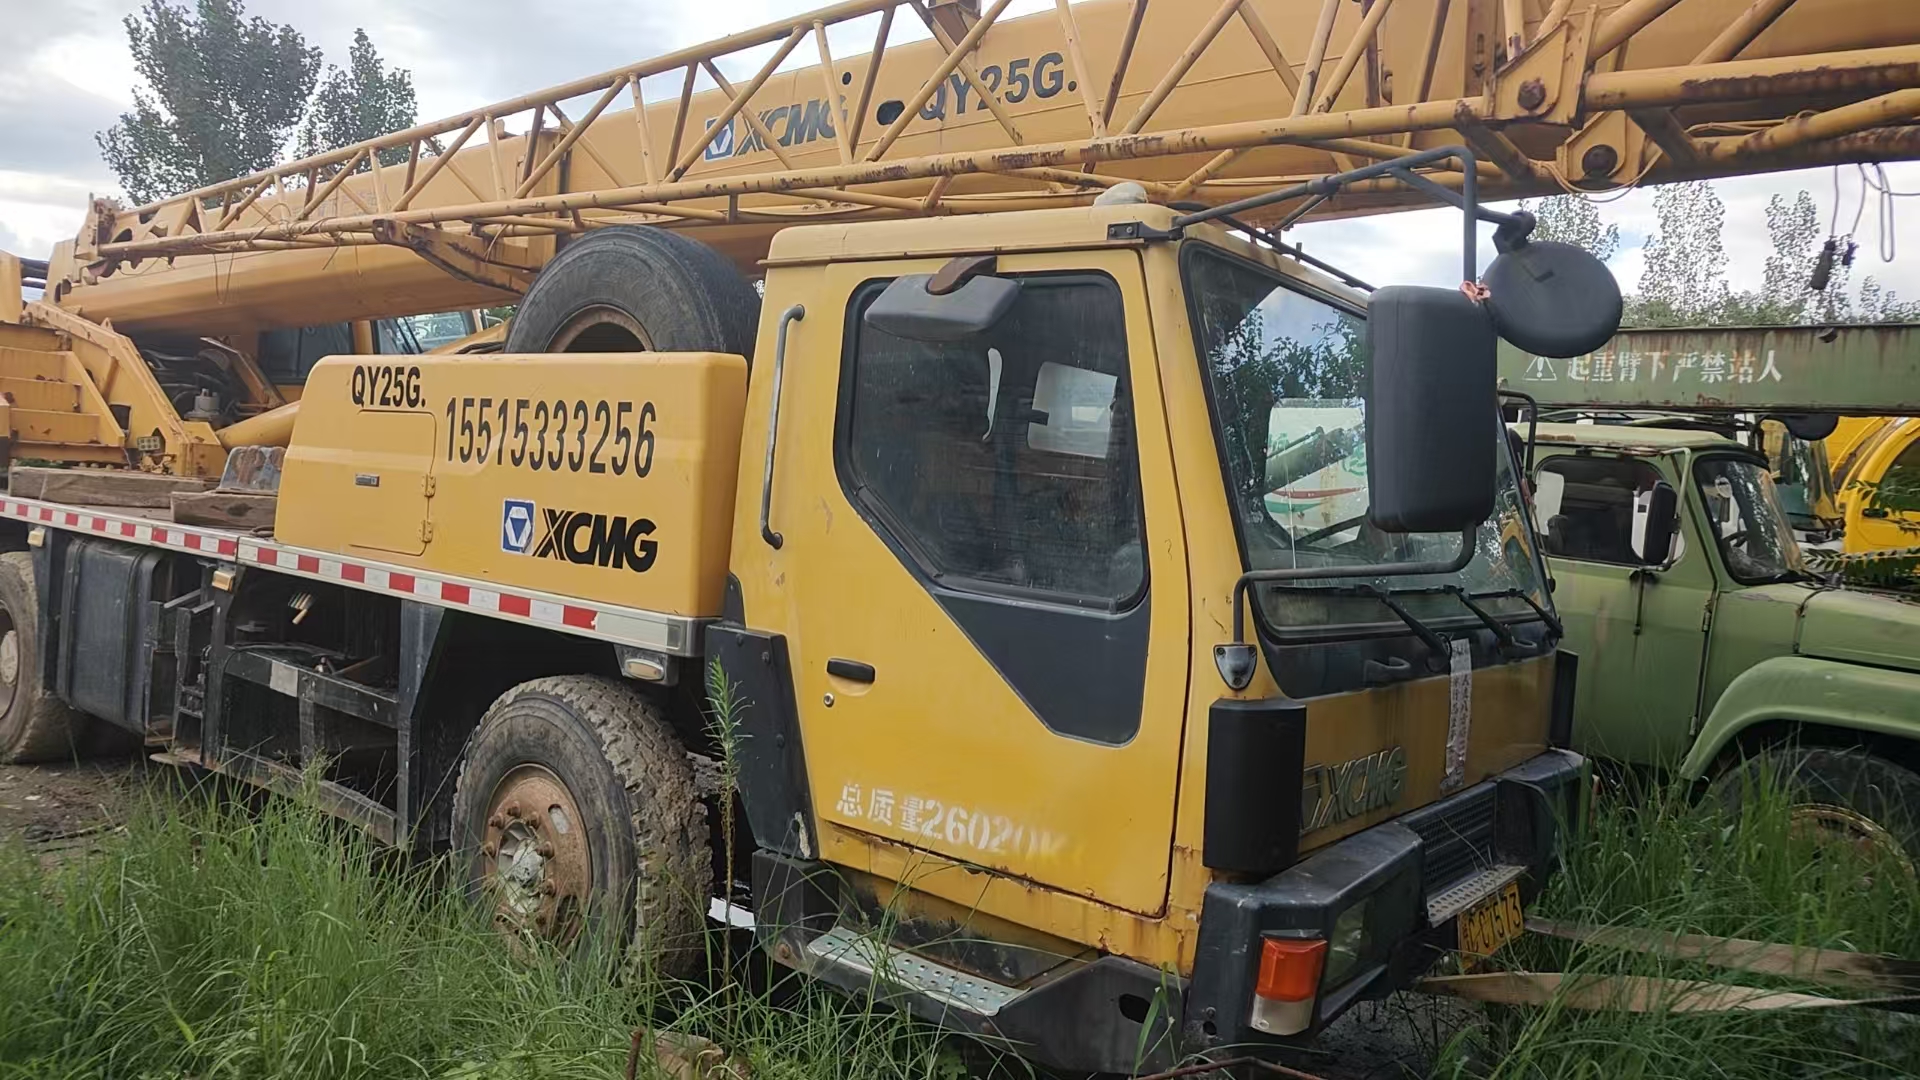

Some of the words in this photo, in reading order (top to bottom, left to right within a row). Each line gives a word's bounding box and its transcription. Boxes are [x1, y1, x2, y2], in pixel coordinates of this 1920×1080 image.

[352, 366, 426, 408] QY25G.
[1567, 350, 1782, 383] 起重臂下严禁站人
[446, 397, 656, 478] 15515333256
[532, 508, 658, 573] XCMG
[1316, 746, 1408, 828] XCMG
